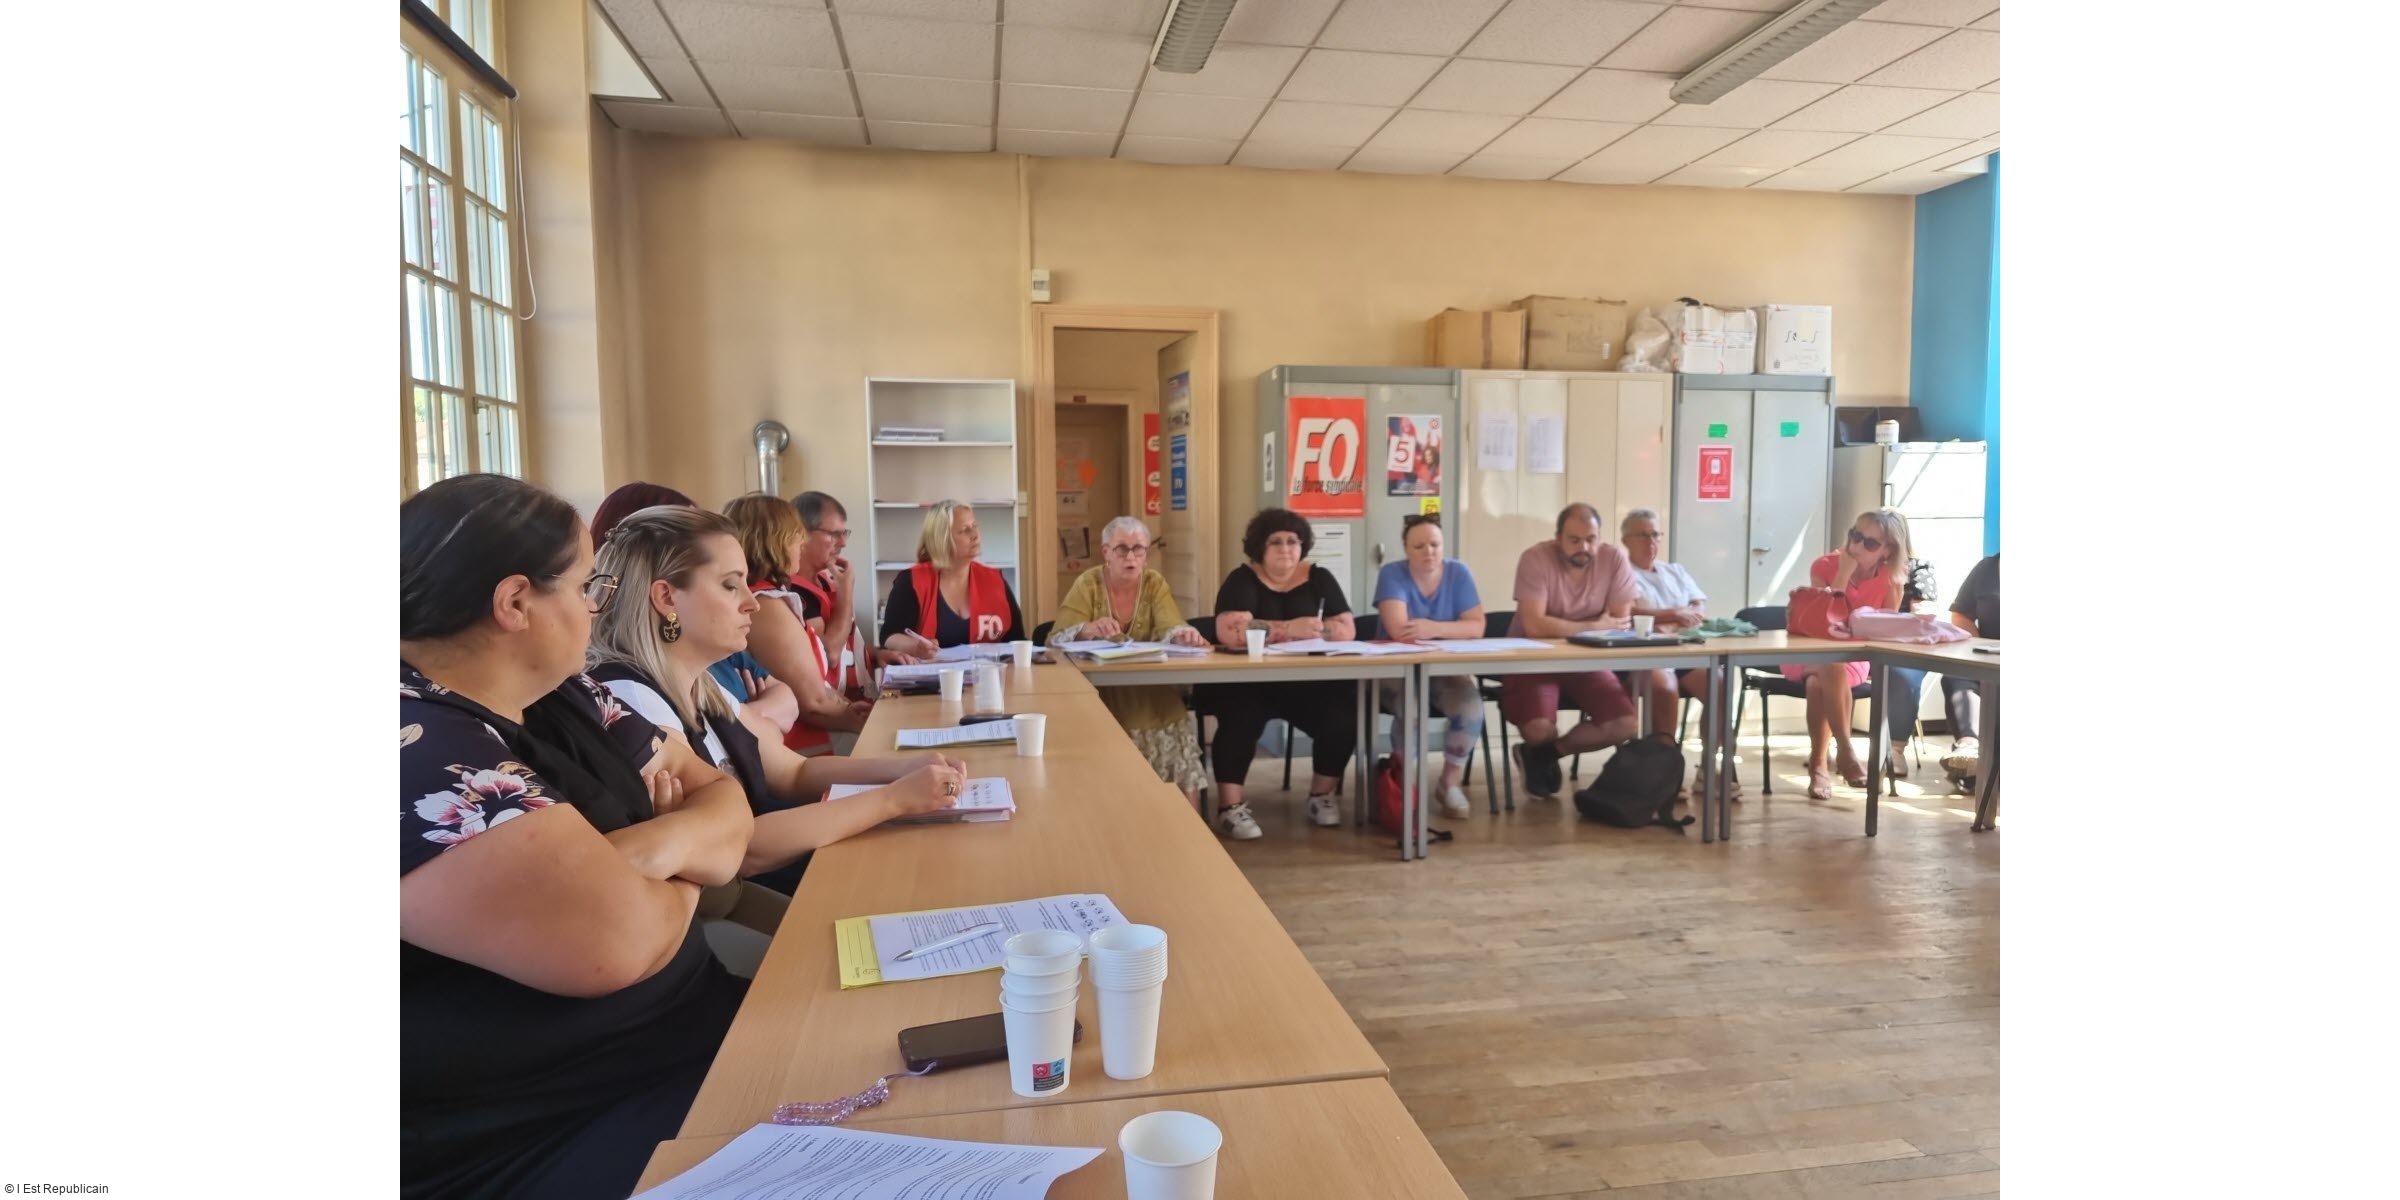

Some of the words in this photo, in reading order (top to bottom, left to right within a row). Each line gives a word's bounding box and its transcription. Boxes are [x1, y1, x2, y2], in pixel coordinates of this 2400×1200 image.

[1289, 417, 1360, 496] FO
[1395, 440, 1409, 463] 5
[977, 614, 1003, 641] FO
